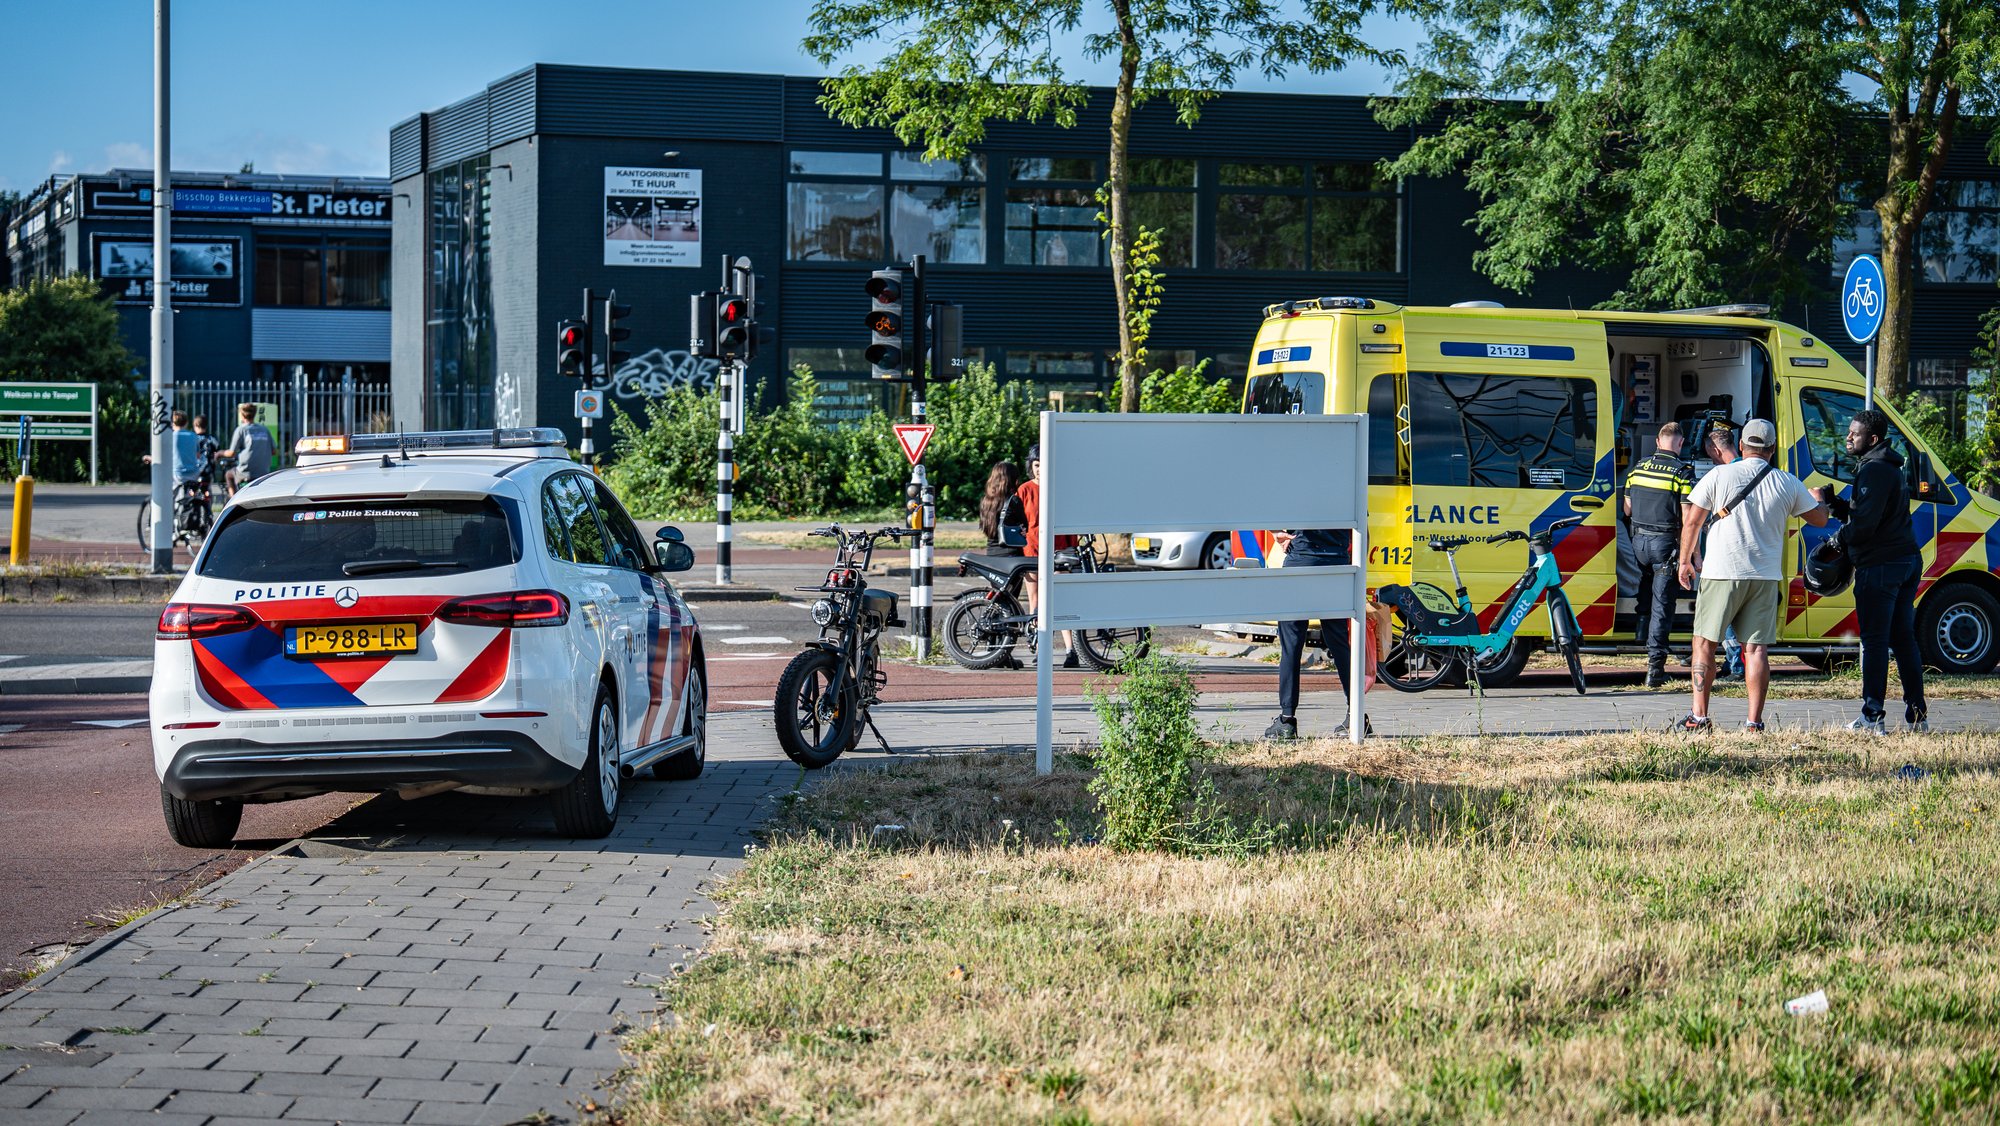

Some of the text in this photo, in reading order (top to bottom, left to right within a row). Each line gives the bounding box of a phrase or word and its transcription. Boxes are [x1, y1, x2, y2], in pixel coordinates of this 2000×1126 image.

[616, 170, 690, 179] KANTOORRUIMTE
[647, 180, 676, 188] HUUR
[176, 191, 271, 203] Bisschop Bekkerslaan
[272, 192, 386, 216] St. Pieter
[1273, 350, 1289, 360] 21-123
[1490, 346, 1526, 356] 21-123
[3, 390, 79, 401] Welkom in de Tempel
[328, 509, 419, 518] Politie Eindhoven
[1381, 546, 1412, 565] 1-1-2
[234, 585, 326, 601] POLITIE
[1510, 599, 1531, 626] dott
[304, 628, 407, 650] P-988-LR
